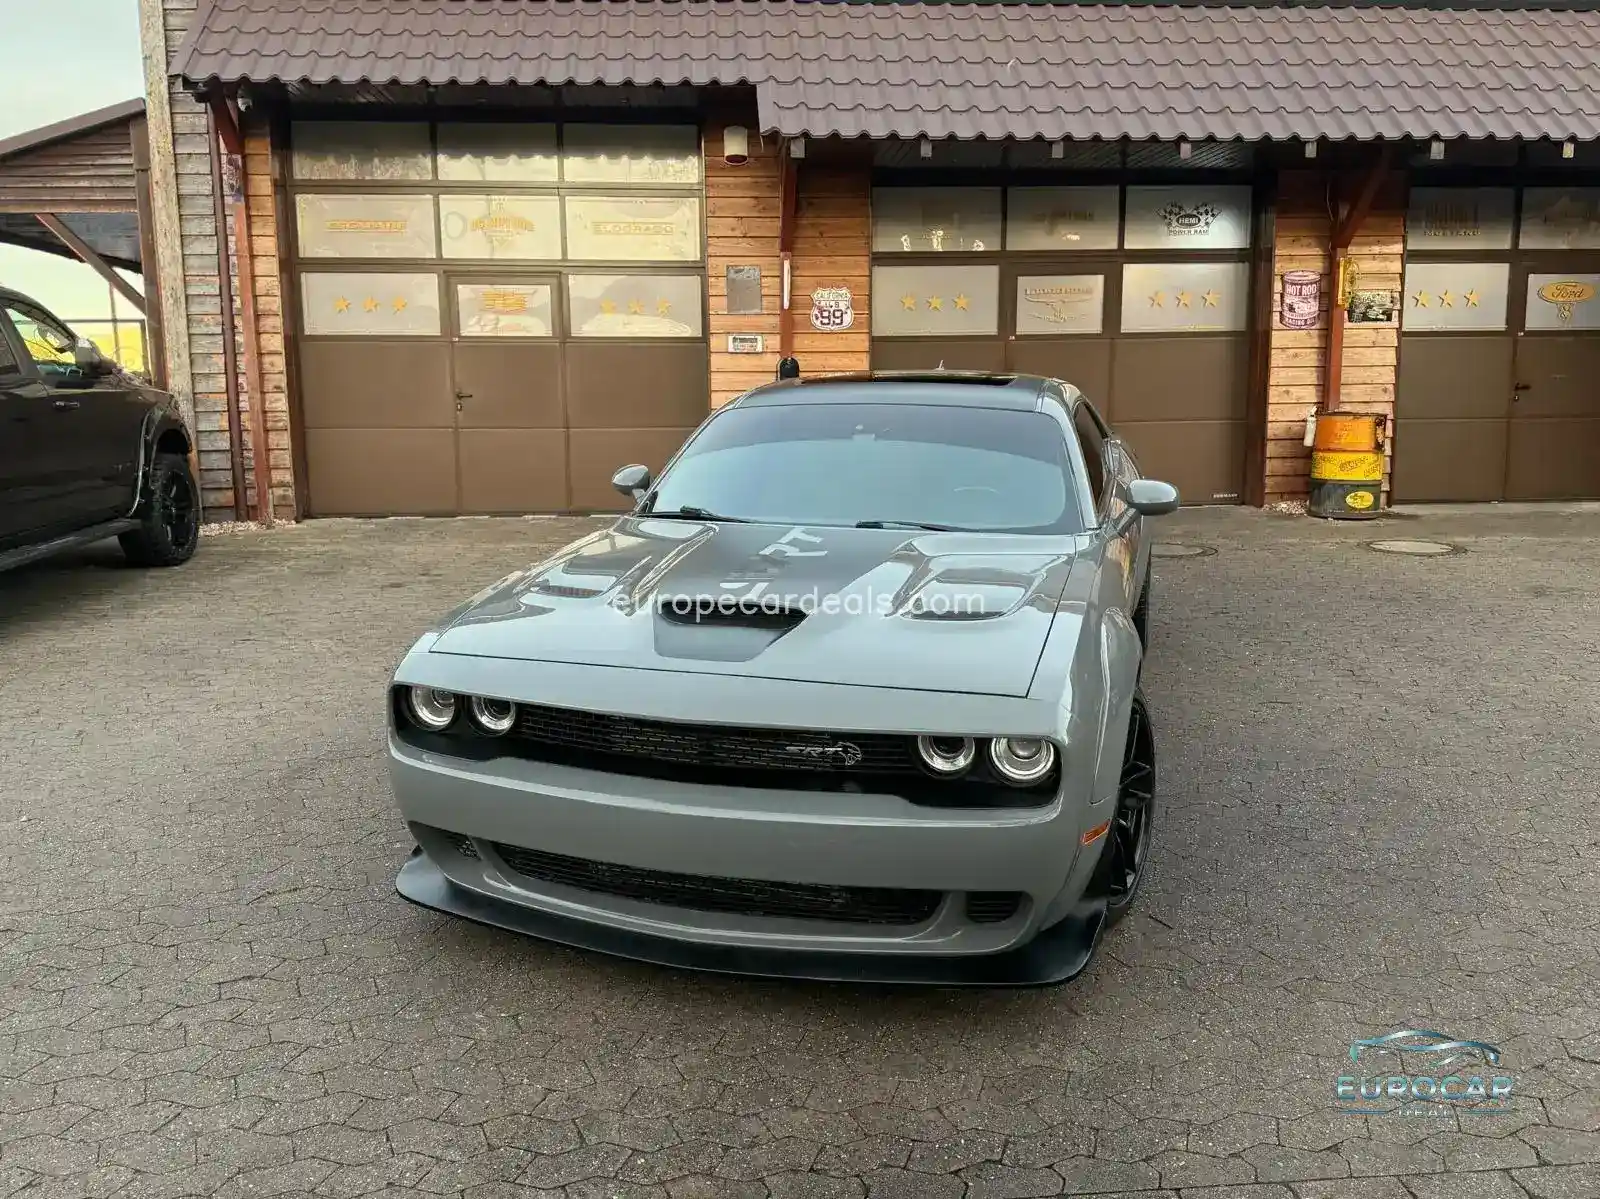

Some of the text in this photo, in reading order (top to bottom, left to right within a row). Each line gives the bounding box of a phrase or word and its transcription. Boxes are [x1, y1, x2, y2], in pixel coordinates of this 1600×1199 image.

[1286, 283, 1317, 296] HOT ROD
[1552, 284, 1584, 299] Ford
[820, 309, 843, 325] 99
